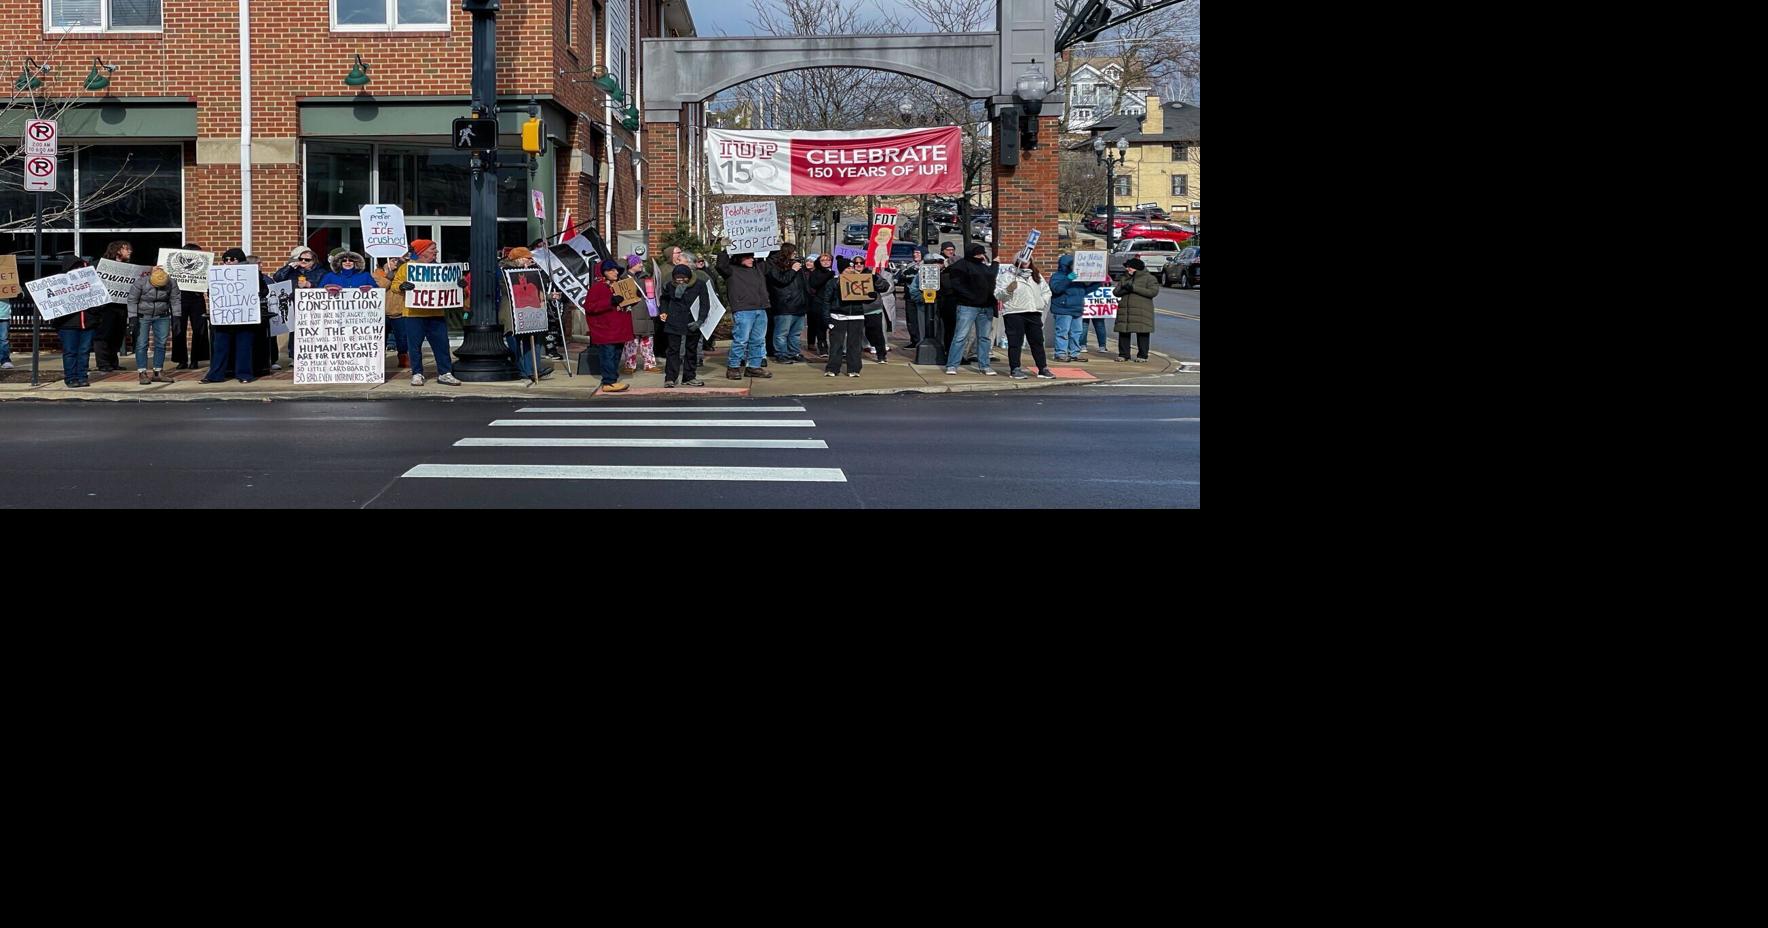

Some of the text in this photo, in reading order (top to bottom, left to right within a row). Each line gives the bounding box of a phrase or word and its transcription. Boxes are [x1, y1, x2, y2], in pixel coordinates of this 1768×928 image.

[719, 139, 778, 159] IUP
[806, 144, 947, 164] CELEBRATE
[719, 160, 778, 184] 150
[807, 163, 947, 178] 150 YEARS OF IUP!
[375, 206, 387, 214] I
[874, 214, 897, 225] FDT
[371, 227, 394, 235] ICE
[727, 226, 745, 237] FEED
[367, 233, 406, 245] crushed
[730, 236, 778, 251] STOP ICE
[1, 272, 15, 280] ET
[210, 268, 247, 282] ICE
[407, 264, 462, 283] RENEE GOOD
[2, 285, 17, 295] CE
[46, 281, 91, 298] American
[210, 281, 245, 296] STOP
[845, 280, 870, 296] ICE
[1086, 288, 1112, 298] CE
[300, 290, 378, 300] PROTECT OUR
[413, 288, 461, 307] ICE EVIL
[212, 294, 258, 309] KILLING
[297, 300, 382, 311] CONSTITUTION!
[211, 308, 258, 324] PEOPLE
[299, 325, 384, 337] TAX THE RICH!
[299, 342, 378, 353] HUMAN RIGHTS
[331, 351, 378, 359] EVERYONE!
[295, 372, 305, 383] SO
[319, 373, 333, 382] EVEN
